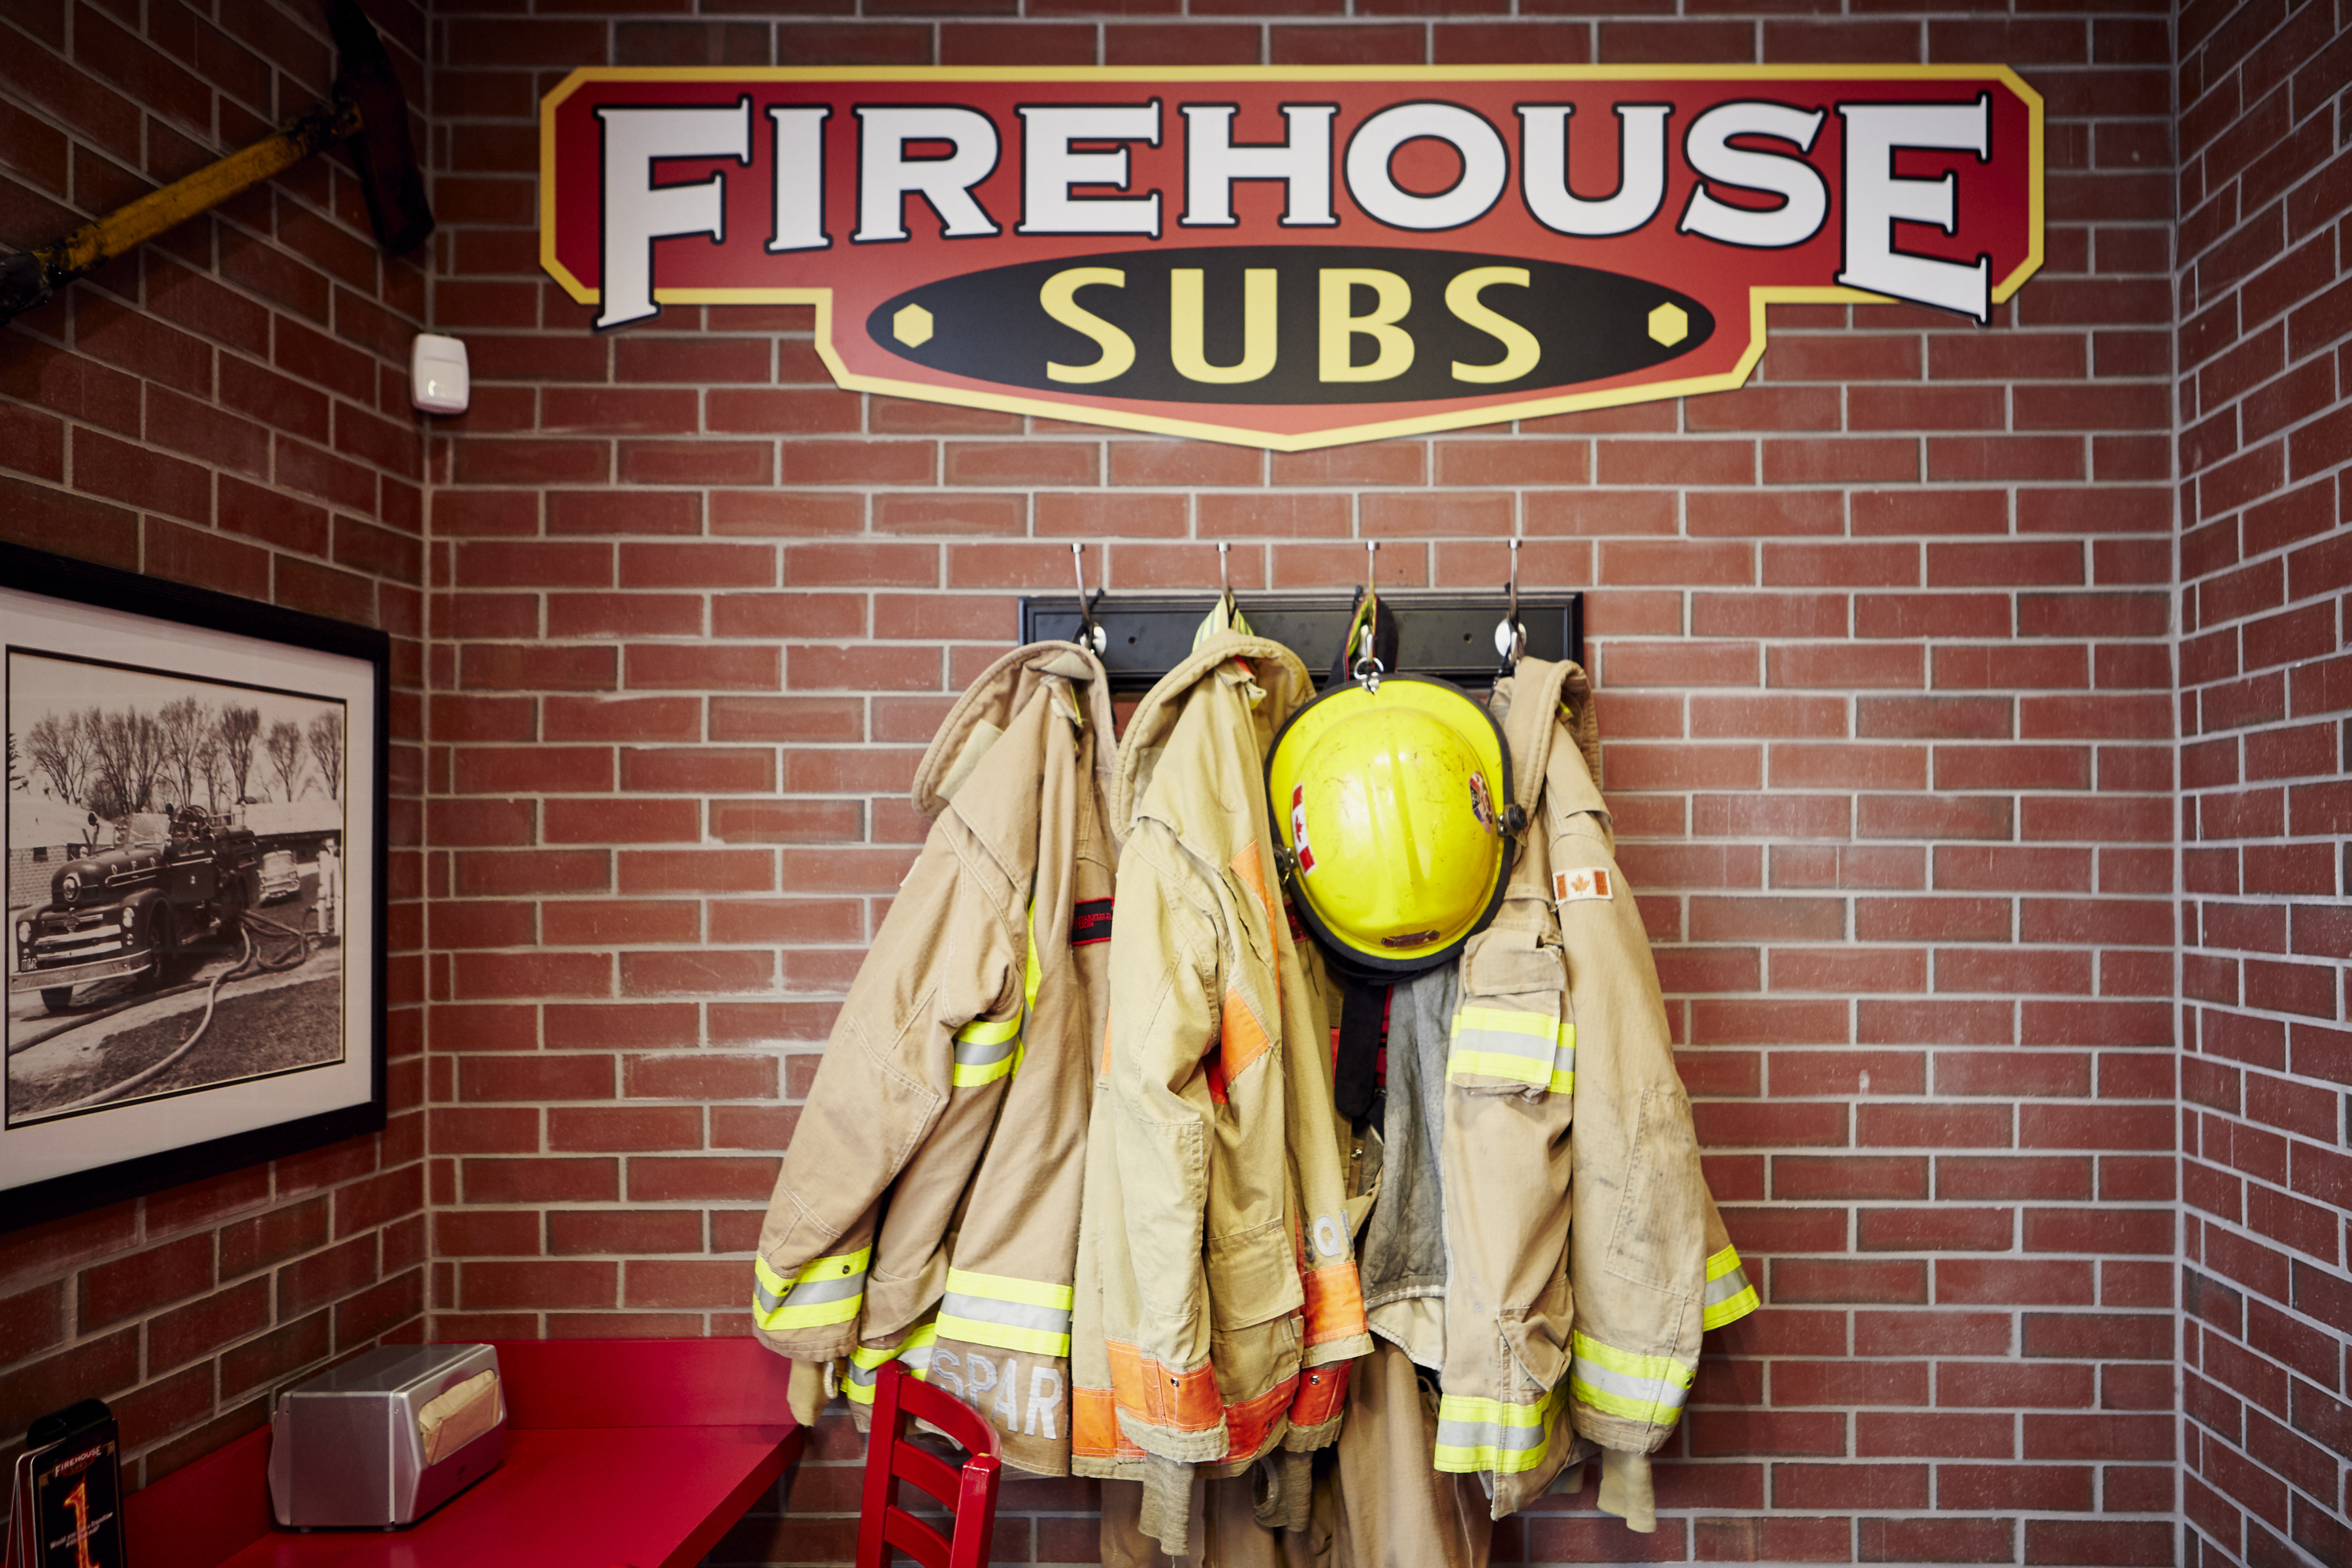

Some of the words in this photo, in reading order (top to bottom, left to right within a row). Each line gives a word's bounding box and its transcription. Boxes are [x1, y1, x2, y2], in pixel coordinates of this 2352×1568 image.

[593, 93, 1990, 333] FIREHOUSE
[1039, 266, 1541, 384] SUBS
[932, 1347, 1063, 1440] SPAR
[55, 1446, 101, 1477] FIREHOUSE
